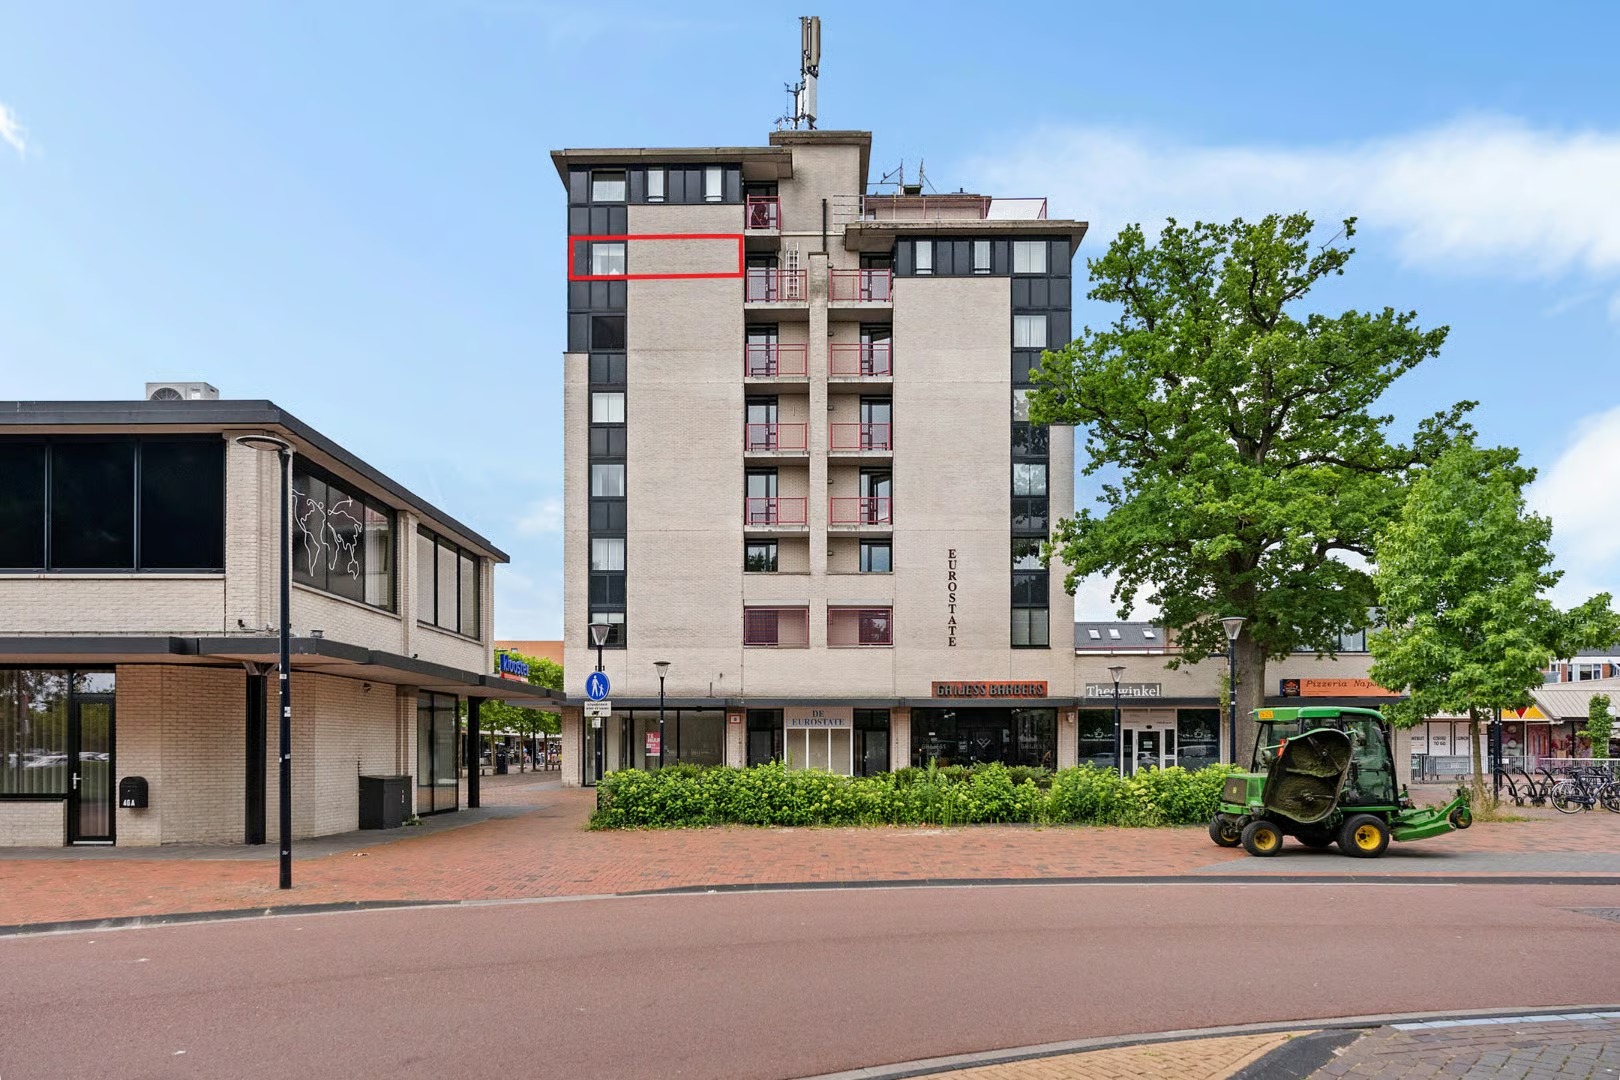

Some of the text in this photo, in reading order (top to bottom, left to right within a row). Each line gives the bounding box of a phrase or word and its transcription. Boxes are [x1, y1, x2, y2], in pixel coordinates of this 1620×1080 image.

[948, 549, 957, 647] EUROSTATE
[1306, 679, 1348, 688] Pizzeria
[989, 684, 1044, 696] BARBERS
[1086, 684, 1161, 697] Theewinkel
[812, 710, 825, 718] DE
[792, 718, 845, 726] EUROSTATE
